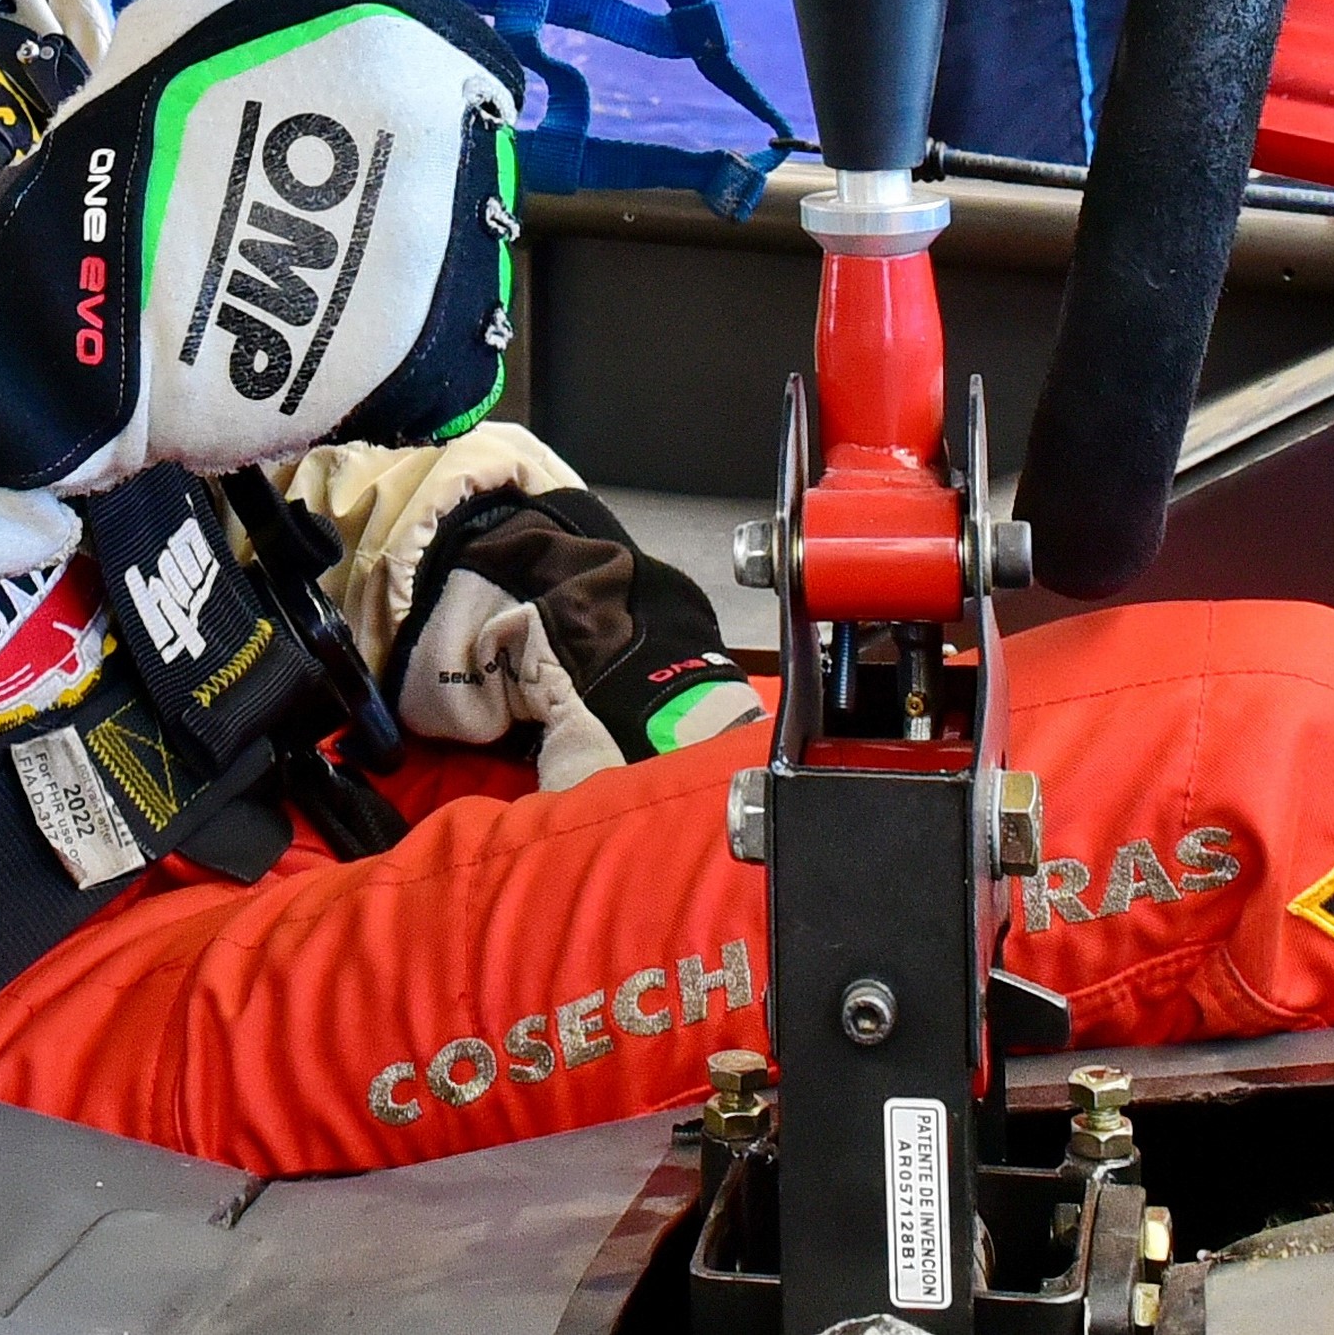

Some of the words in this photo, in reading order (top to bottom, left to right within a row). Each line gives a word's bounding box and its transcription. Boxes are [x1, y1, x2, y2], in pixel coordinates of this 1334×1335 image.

[83, 148, 116, 243] ONE
[216, 112, 360, 401] OMP
[76, 256, 108, 366] EVO
[18, 756, 38, 787] FIA
[35, 752, 52, 781] For
[46, 782, 66, 815] FHR
[57, 818, 74, 845] use
[63, 783, 95, 838] 2022
[916, 1114, 933, 1183] PATENTE
[918, 1187, 934, 1207] DE
[919, 1211, 937, 1297] INVENCION
